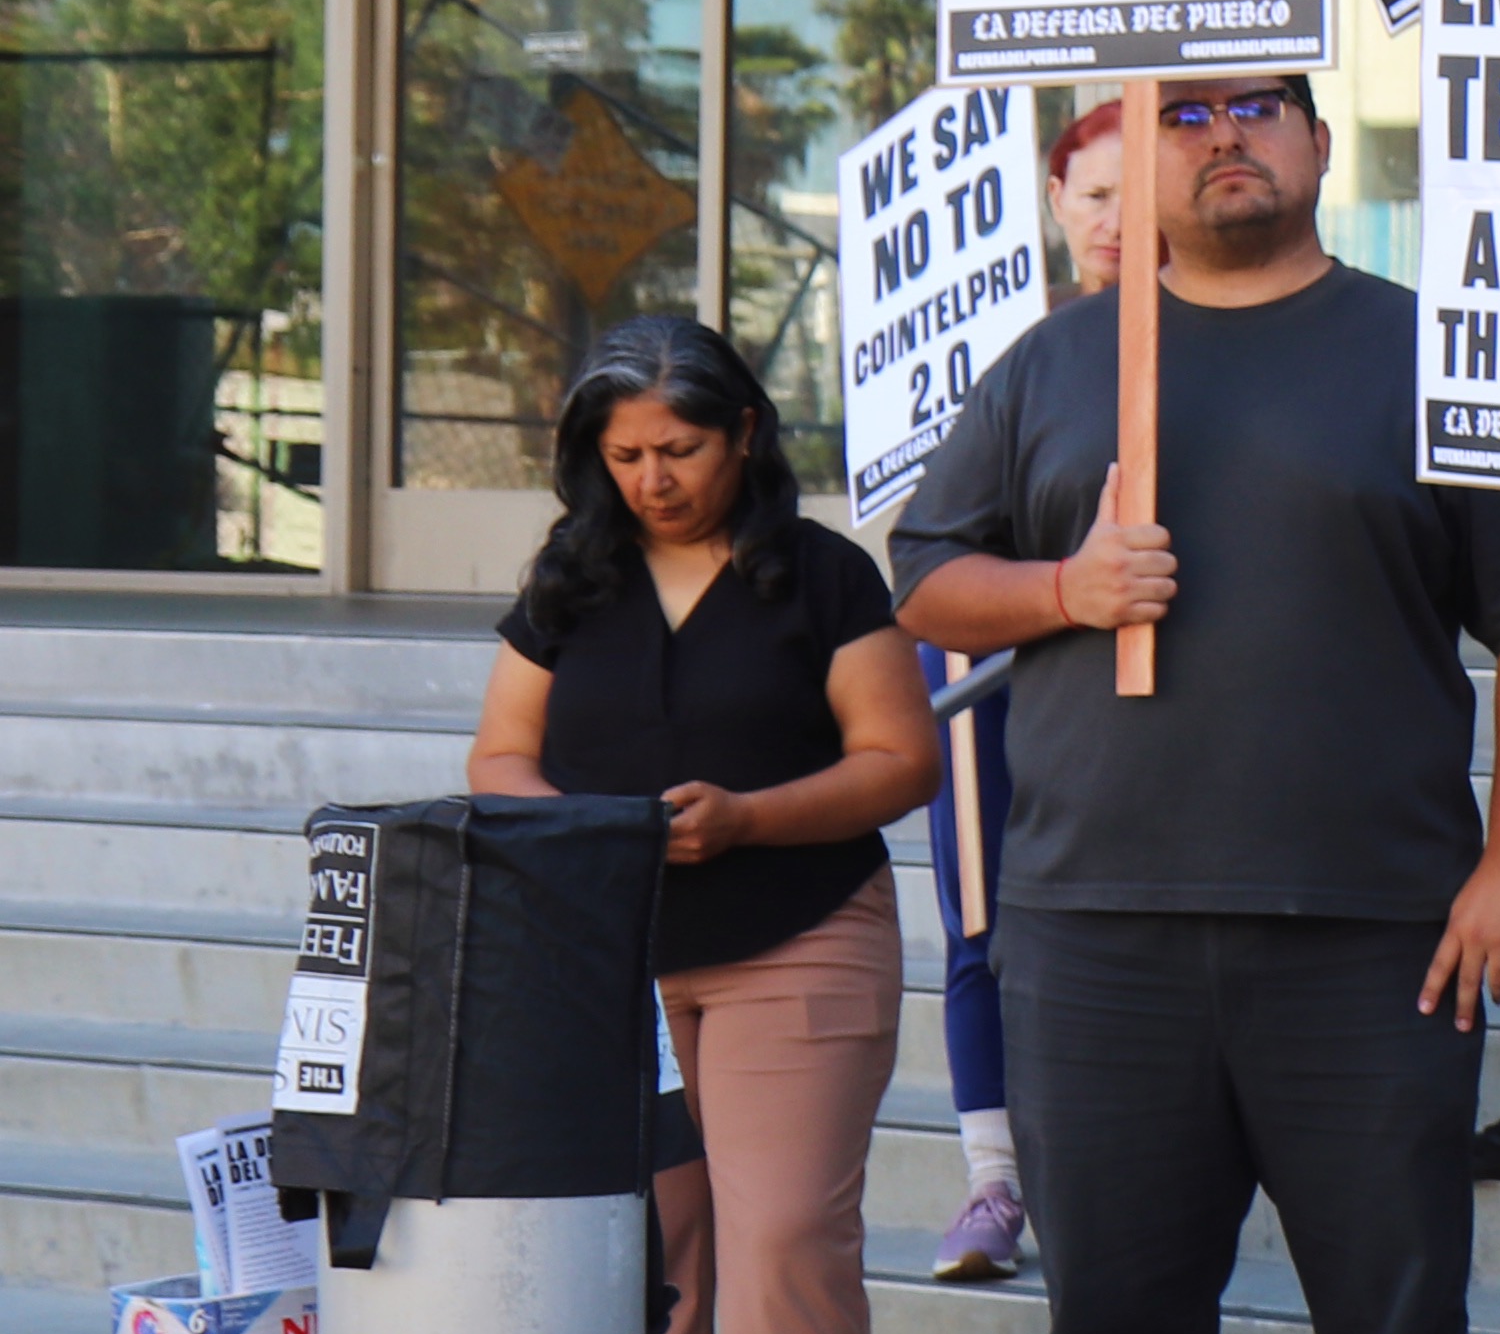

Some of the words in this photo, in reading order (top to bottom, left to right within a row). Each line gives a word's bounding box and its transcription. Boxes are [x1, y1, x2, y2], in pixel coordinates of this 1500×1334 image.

[1131, 3, 1181, 33] DEL
[859, 127, 918, 221] WE
[932, 87, 1009, 172] SAY
[872, 208, 930, 305] NO
[946, 165, 1002, 253] TO
[853, 244, 1031, 387] COINTELPRO
[910, 340, 972, 430] 2.0
